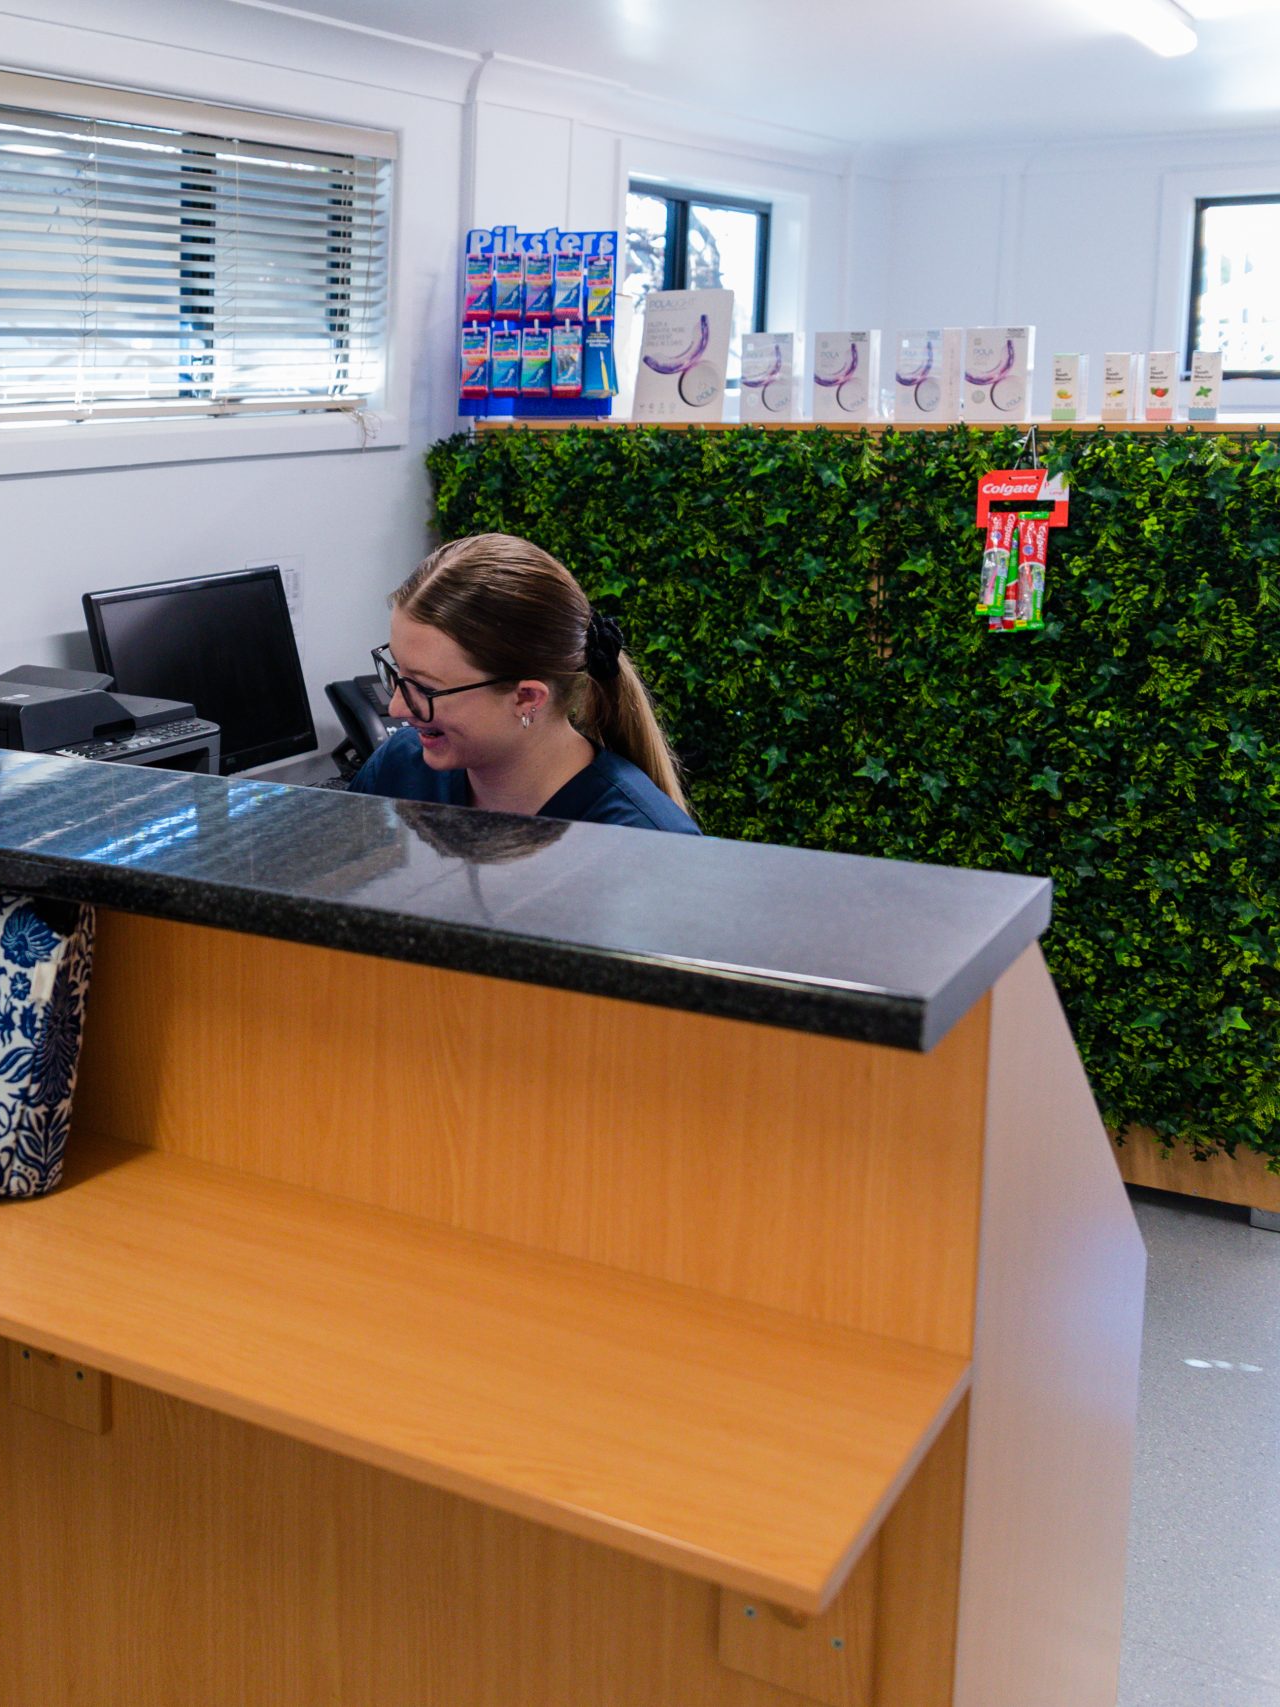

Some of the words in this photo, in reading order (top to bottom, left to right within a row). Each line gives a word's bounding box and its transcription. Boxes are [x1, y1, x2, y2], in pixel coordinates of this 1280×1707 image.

[470, 226, 614, 255] Piksters
[982, 483, 1037, 496] Colgate
[1003, 513, 1016, 547] Colgate
[1036, 525, 1047, 560] Colgate
